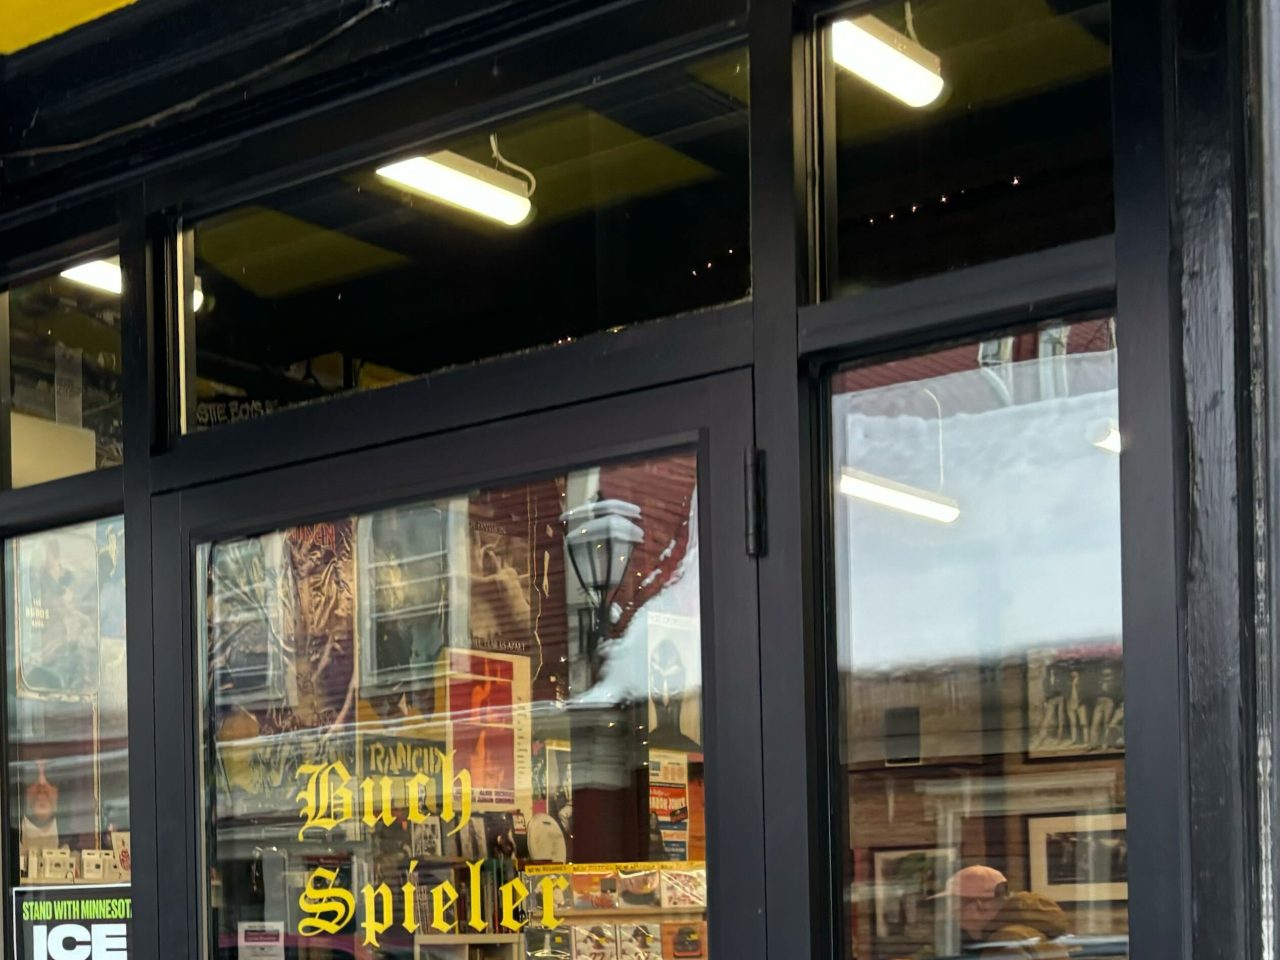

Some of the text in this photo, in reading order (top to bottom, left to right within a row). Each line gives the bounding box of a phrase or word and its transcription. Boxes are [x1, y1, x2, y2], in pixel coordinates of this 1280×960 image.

[369, 741, 442, 775] RANCID
[295, 749, 472, 842] Buch
[22, 898, 133, 921] STAND WITH MINNESOT
[298, 858, 570, 949] Spieler
